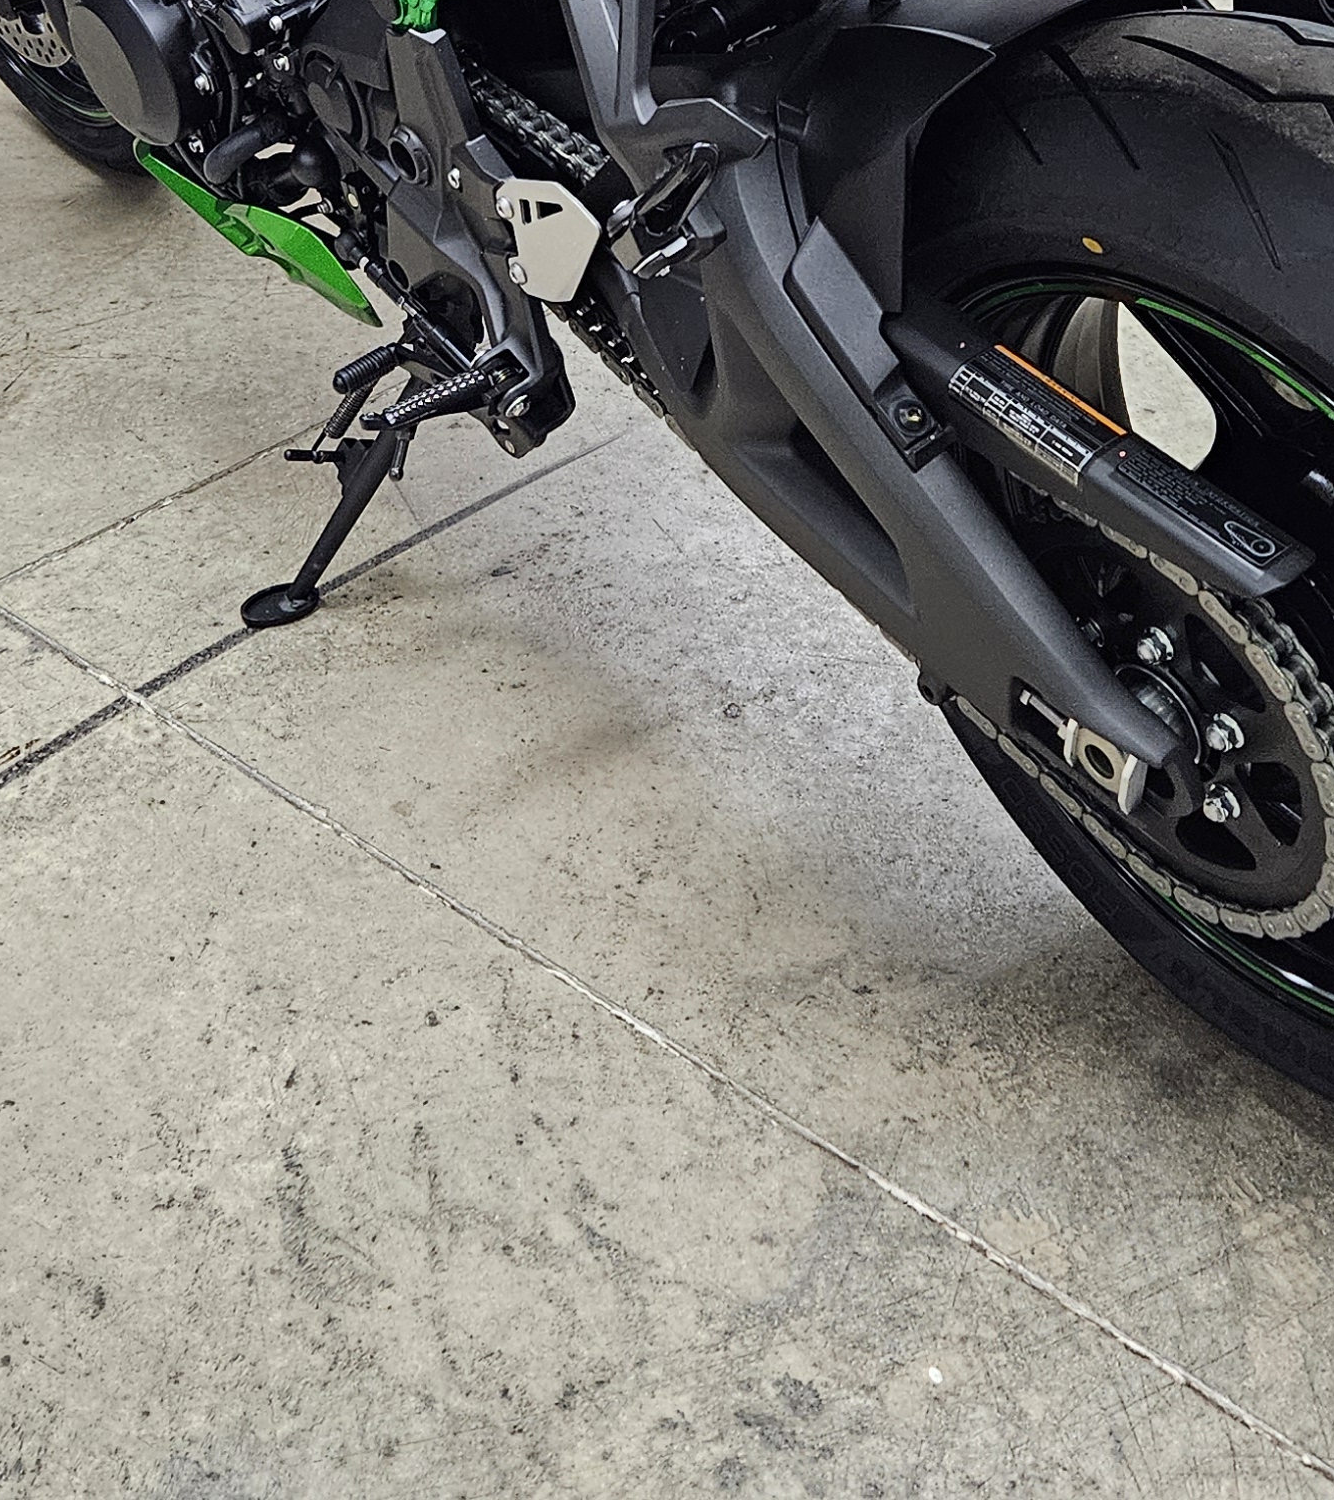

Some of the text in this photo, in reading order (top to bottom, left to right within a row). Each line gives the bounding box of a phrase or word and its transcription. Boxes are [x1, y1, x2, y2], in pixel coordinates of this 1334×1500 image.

[1000, 379, 1068, 430] TIRE AND LOAD DATA
